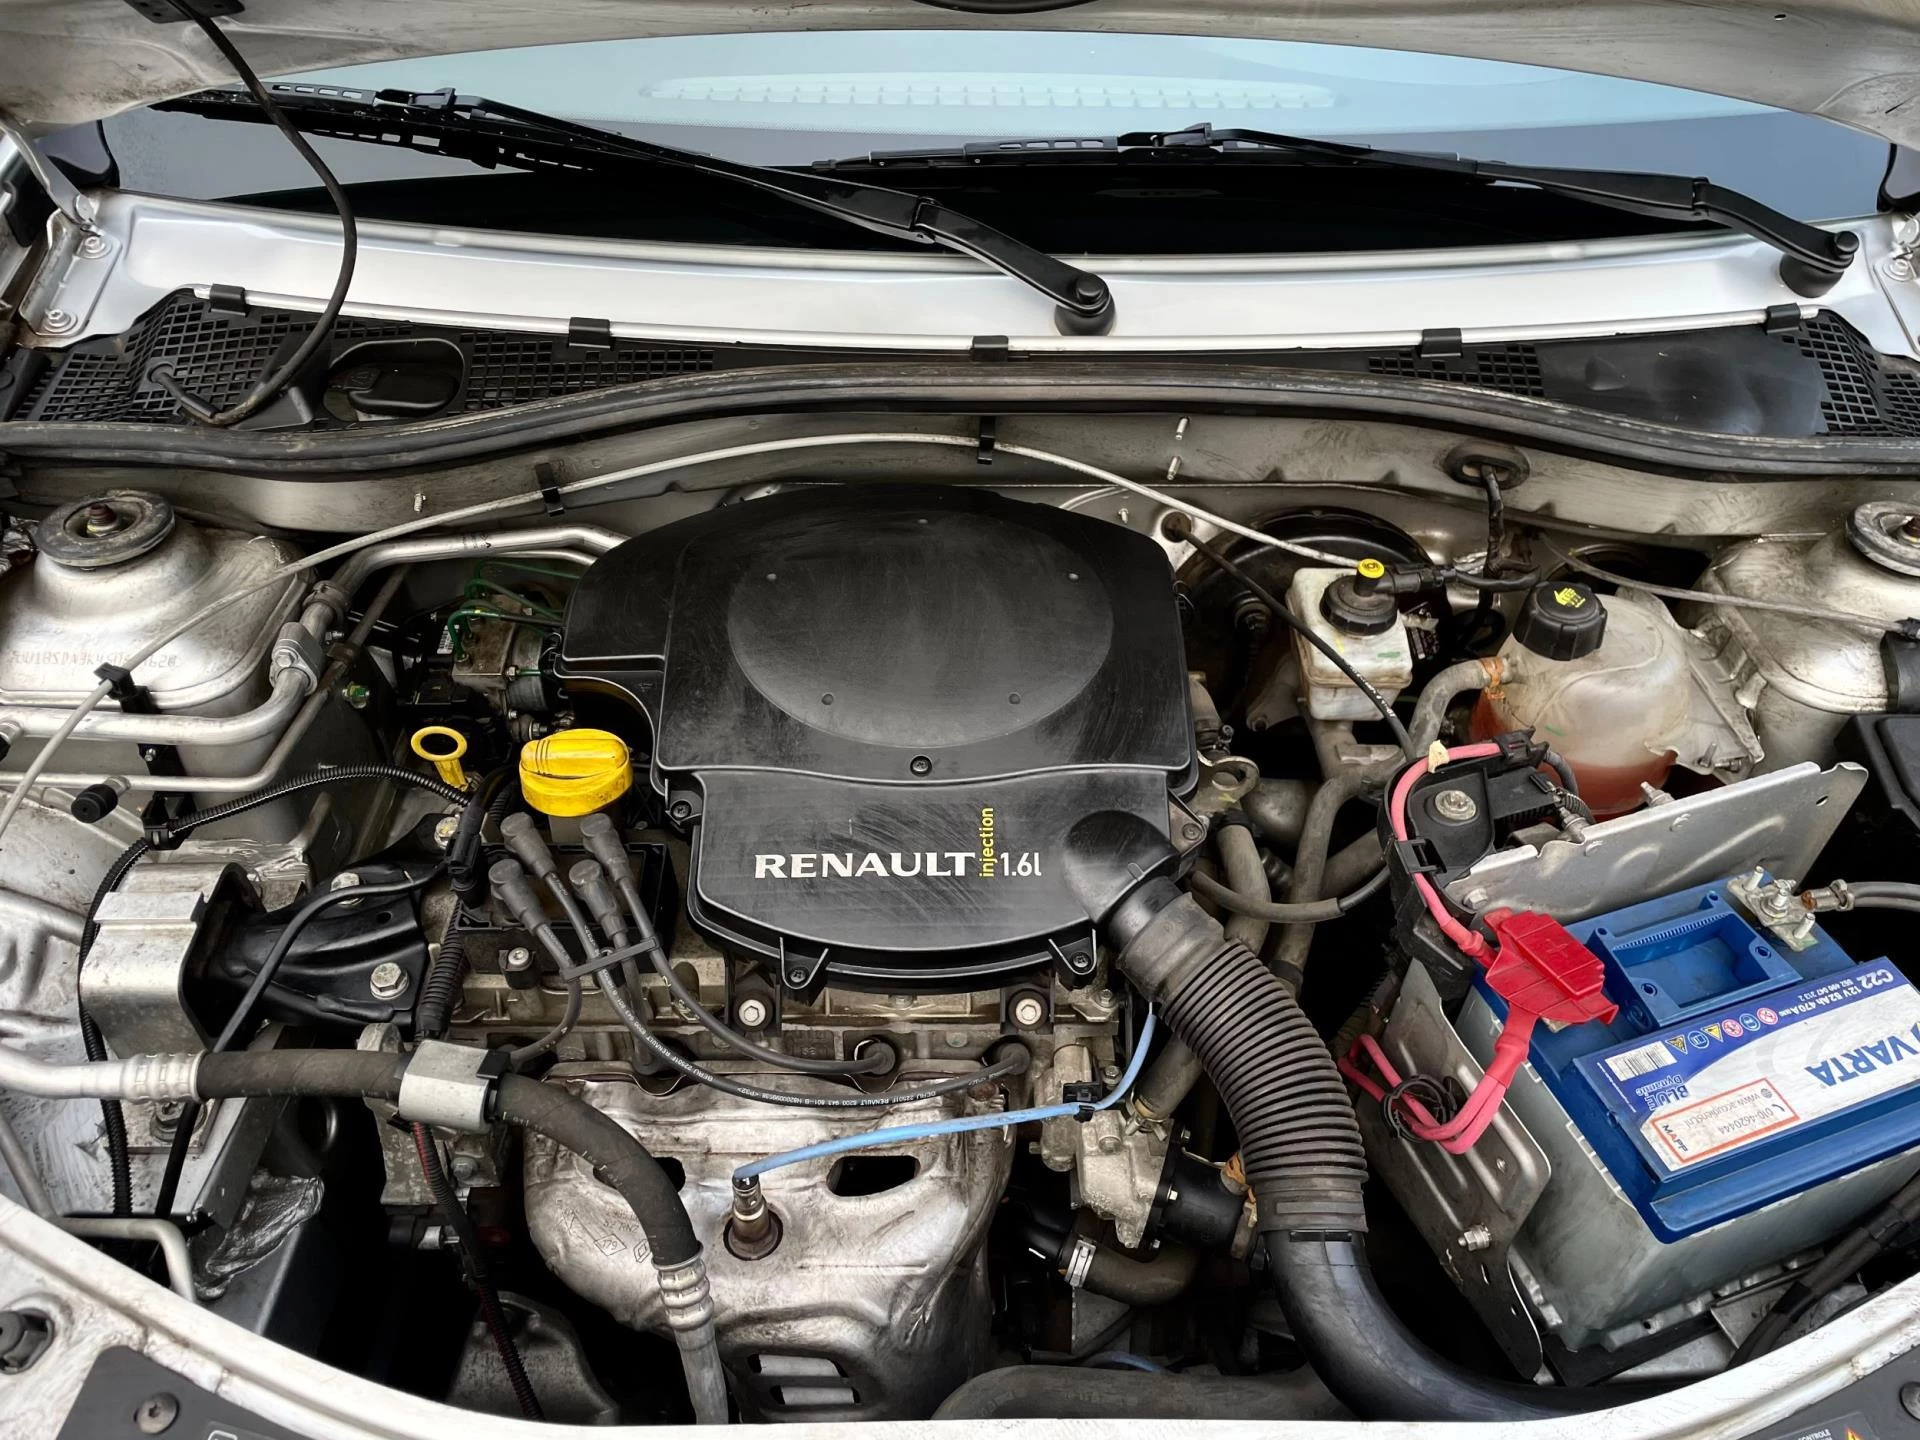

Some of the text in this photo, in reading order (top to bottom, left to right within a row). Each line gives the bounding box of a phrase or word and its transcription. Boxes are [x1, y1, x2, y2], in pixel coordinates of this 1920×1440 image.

[978, 807, 998, 878] injection
[754, 851, 976, 879] RENAULT
[1843, 985, 1862, 998] 12V
[1856, 969, 1894, 989] C22
[646, 1036, 671, 1057] RENAULT
[1804, 1035, 1920, 1087] VARTA
[1635, 1074, 1683, 1097] Dynamic
[1644, 1084, 1690, 1111] BLUE
[860, 1097, 889, 1107] RENAULT
[1718, 1107, 1774, 1135] 010-4620444
[1662, 1123, 1688, 1152] MAPP
